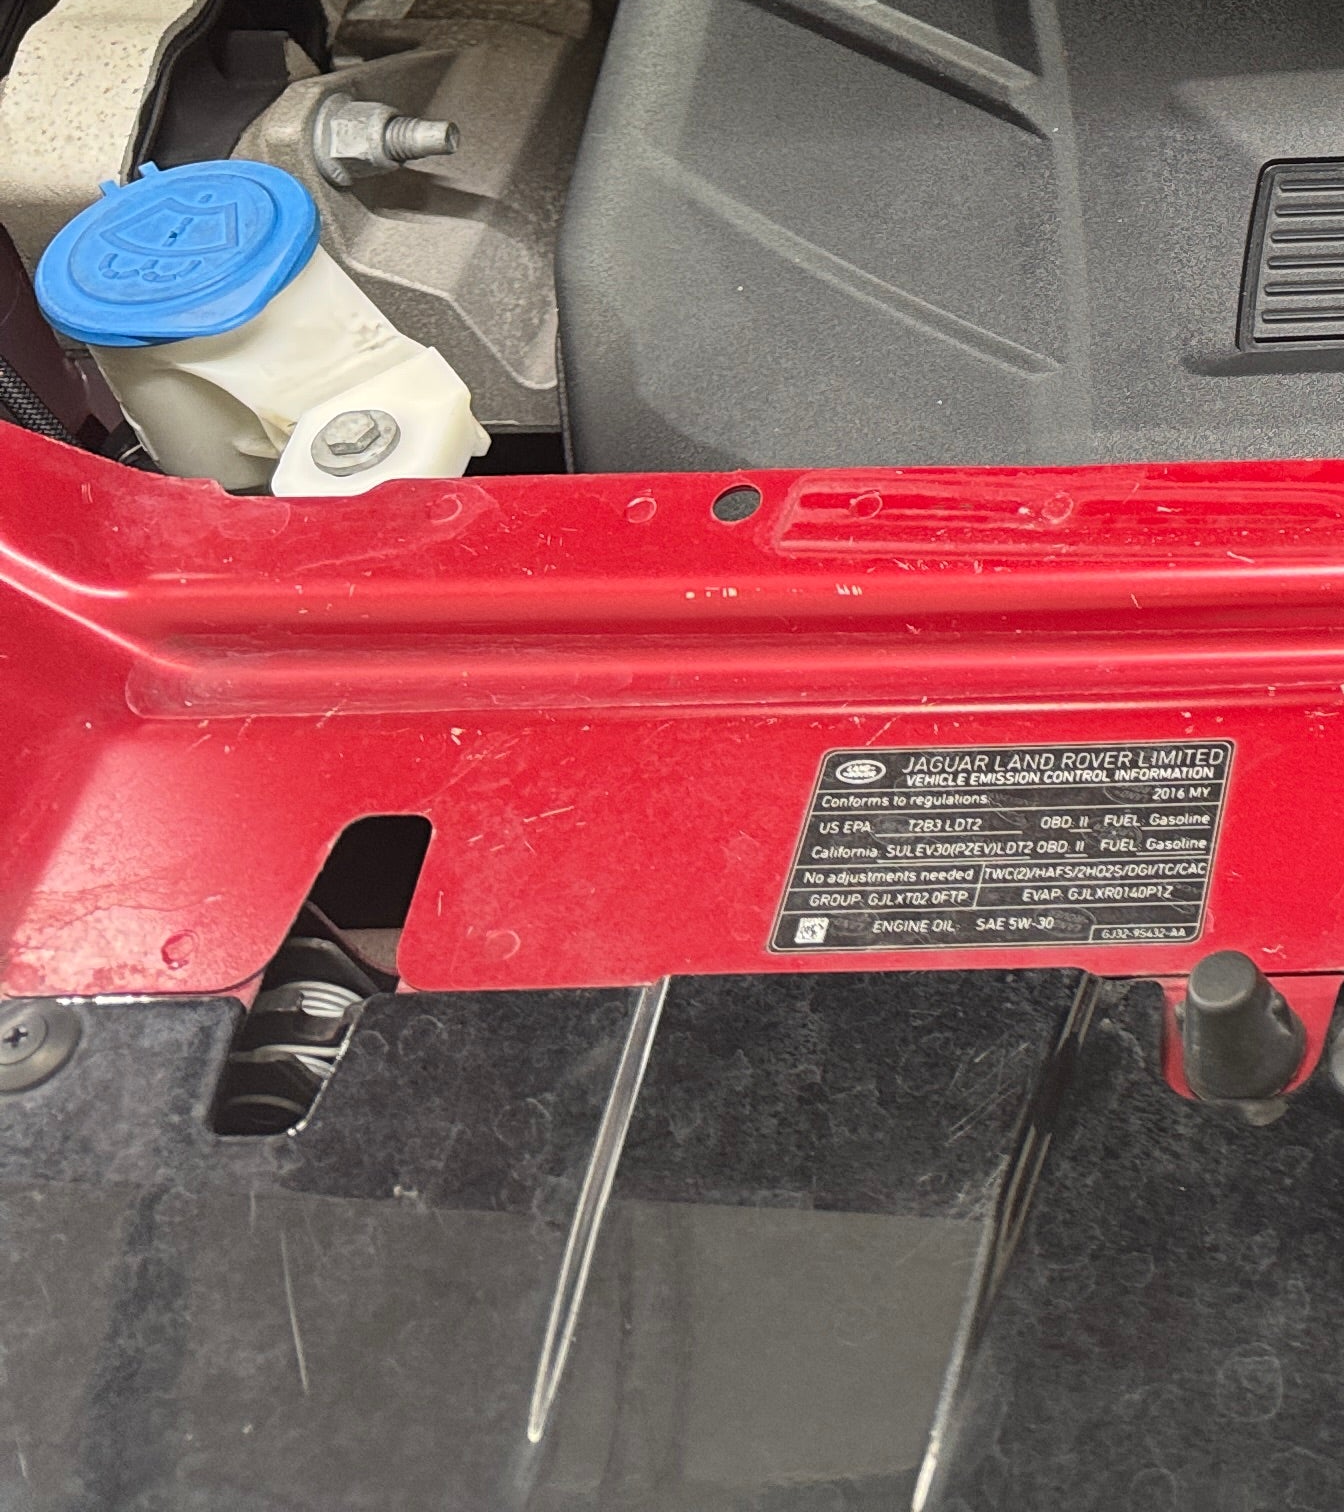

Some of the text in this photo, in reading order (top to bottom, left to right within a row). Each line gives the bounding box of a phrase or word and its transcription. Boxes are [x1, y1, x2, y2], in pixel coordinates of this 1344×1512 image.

[902, 748, 1224, 773] JAGUAR LAND ROVER LIMITED
[906, 767, 1214, 787] VEHICLE EMISSION CONTROL INFORMATION
[822, 795, 889, 808] Conforms
[893, 793, 907, 806] to
[1152, 787, 1185, 800] 2016
[1189, 787, 1212, 798] MY
[819, 821, 840, 834] US
[908, 819, 943, 833] T2B3
[944, 818, 983, 832] LDT2
[1149, 812, 1211, 826] Gasoline
[1145, 838, 1207, 851] Gasoline
[803, 868, 974, 885] No adjustments needed
[872, 920, 930, 934] ENGINE
[975, 917, 1005, 931] SAE
[1008, 916, 1055, 930] 5W-30
